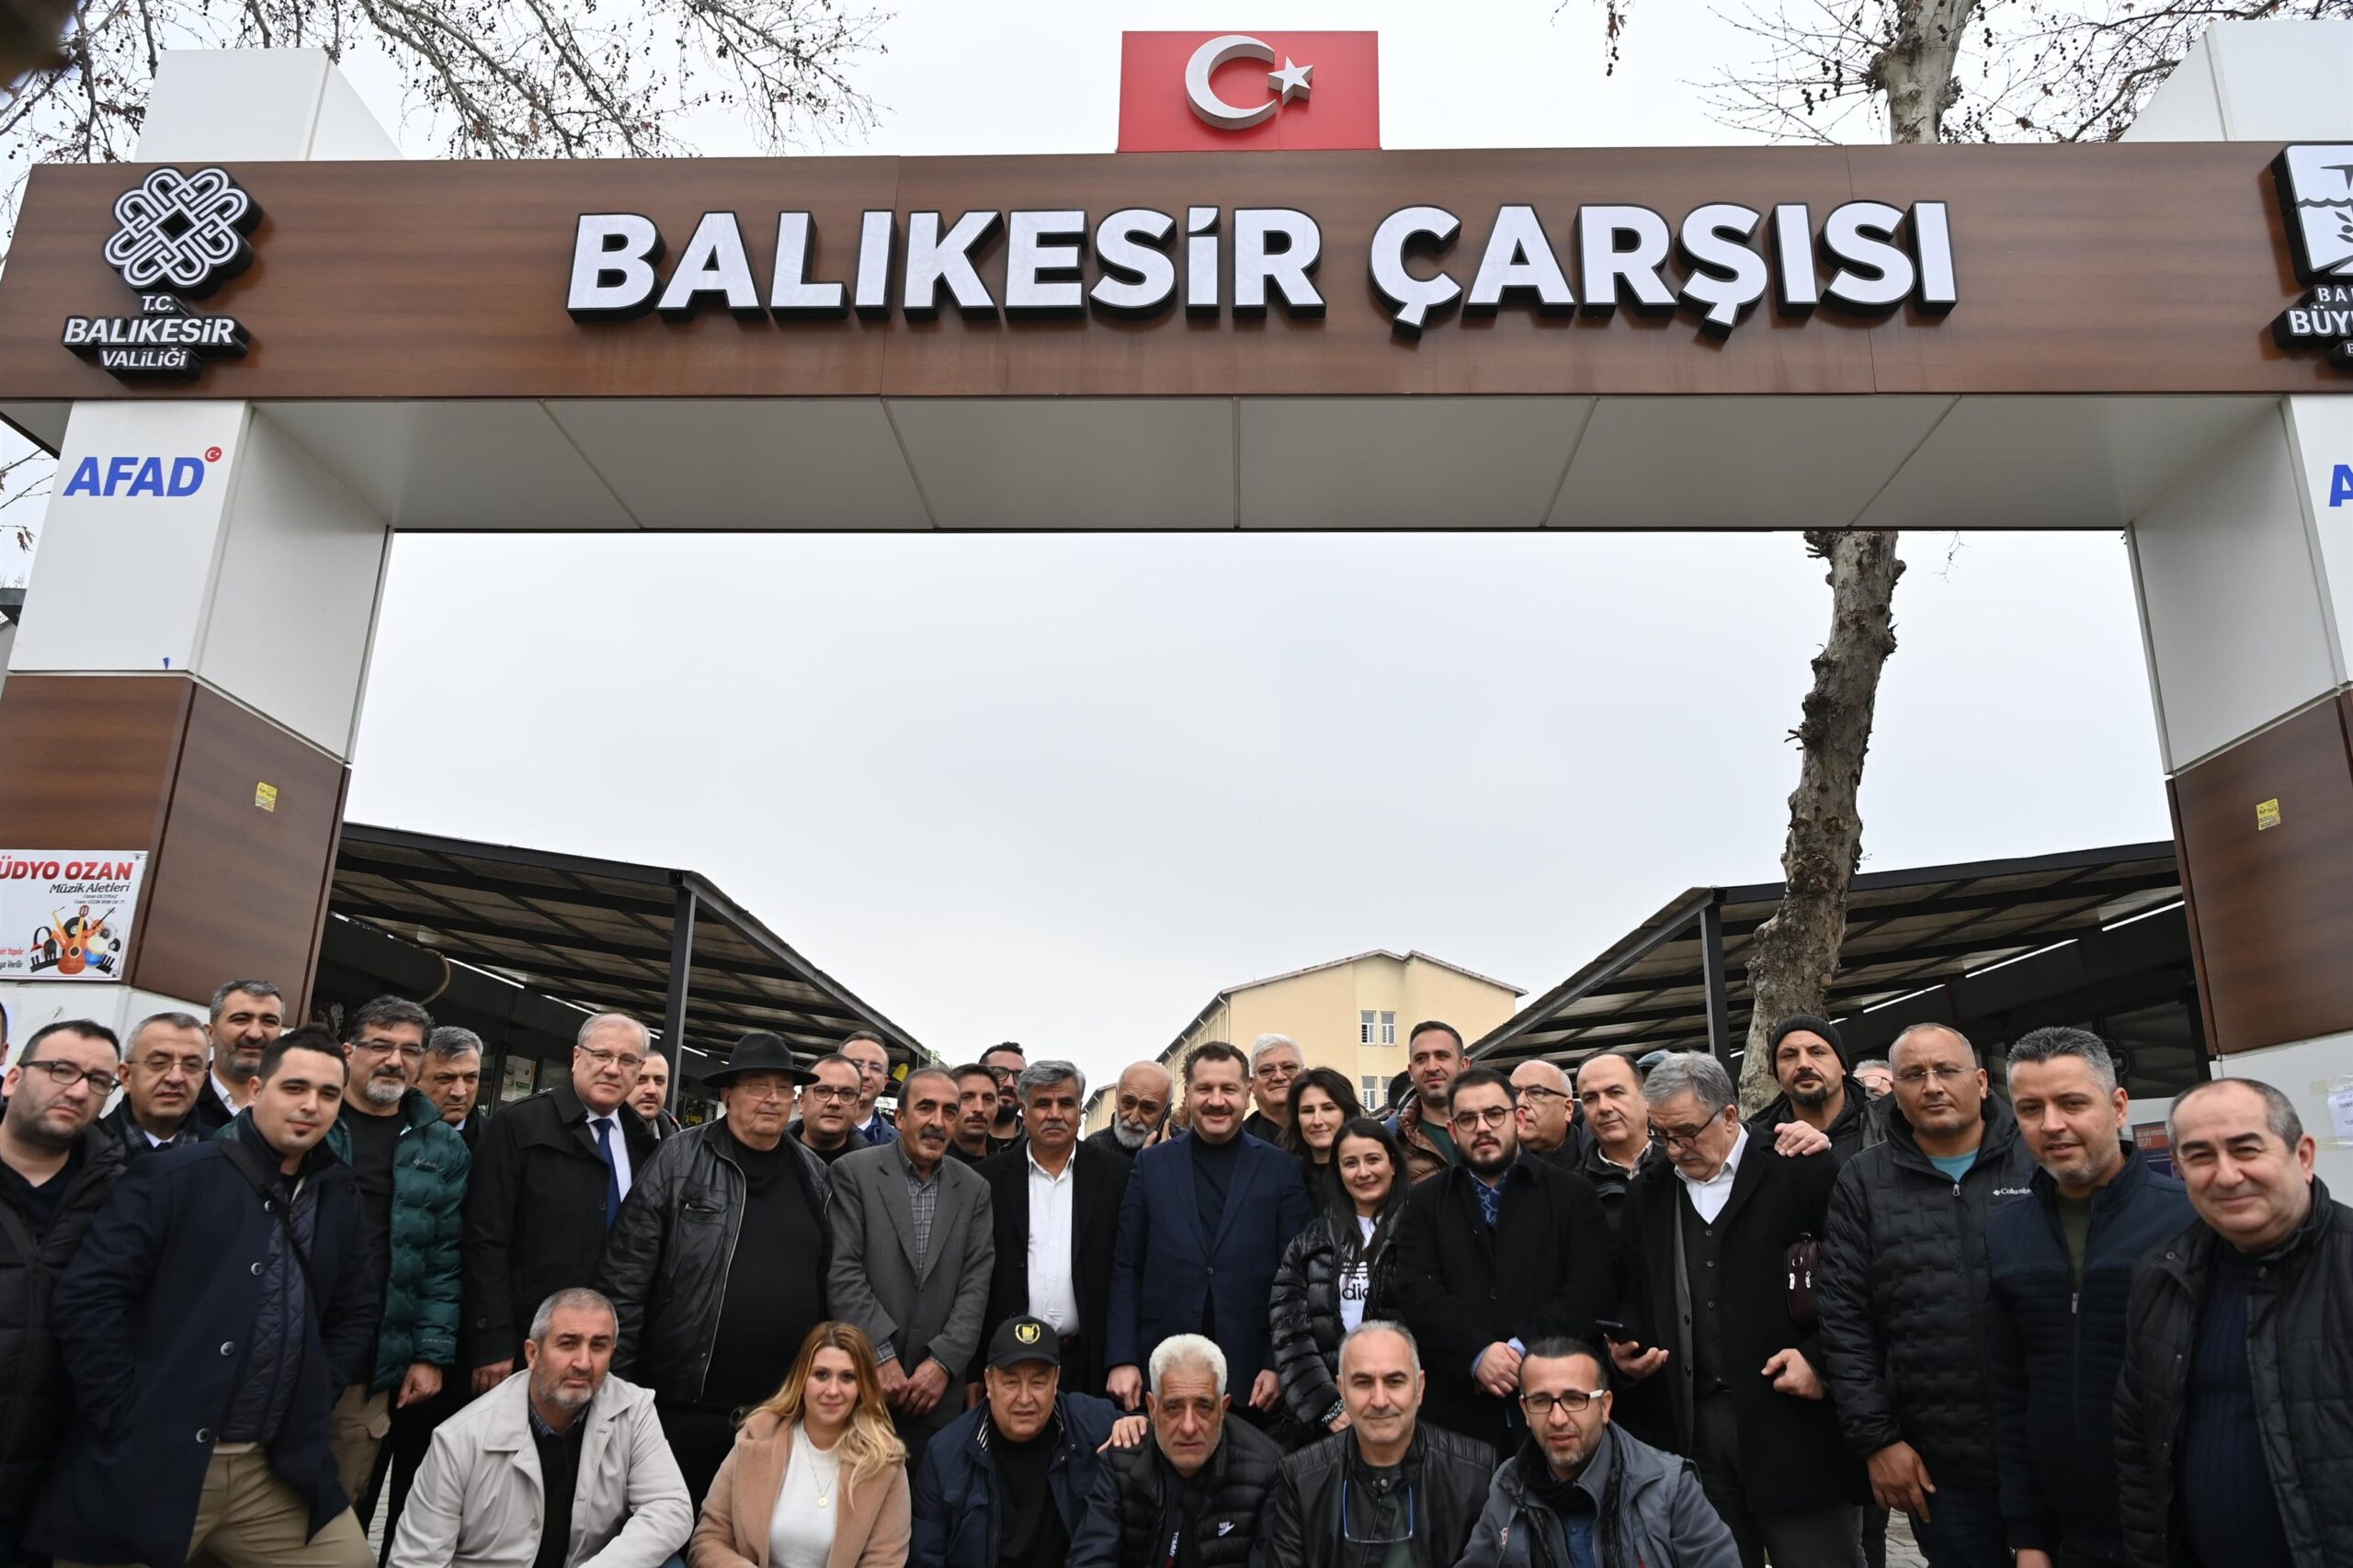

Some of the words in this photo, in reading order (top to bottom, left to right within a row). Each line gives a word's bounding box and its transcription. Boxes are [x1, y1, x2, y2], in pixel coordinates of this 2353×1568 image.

[1369, 199, 1960, 329] ÇARŞISI
[142, 295, 175, 312] T.C.
[2289, 304, 2353, 335] BÜY
[63, 456, 206, 497] AFAD
[64, 861, 134, 881] OZAN
[50, 883, 85, 894] Müzik
[85, 881, 131, 893] Aletleri
